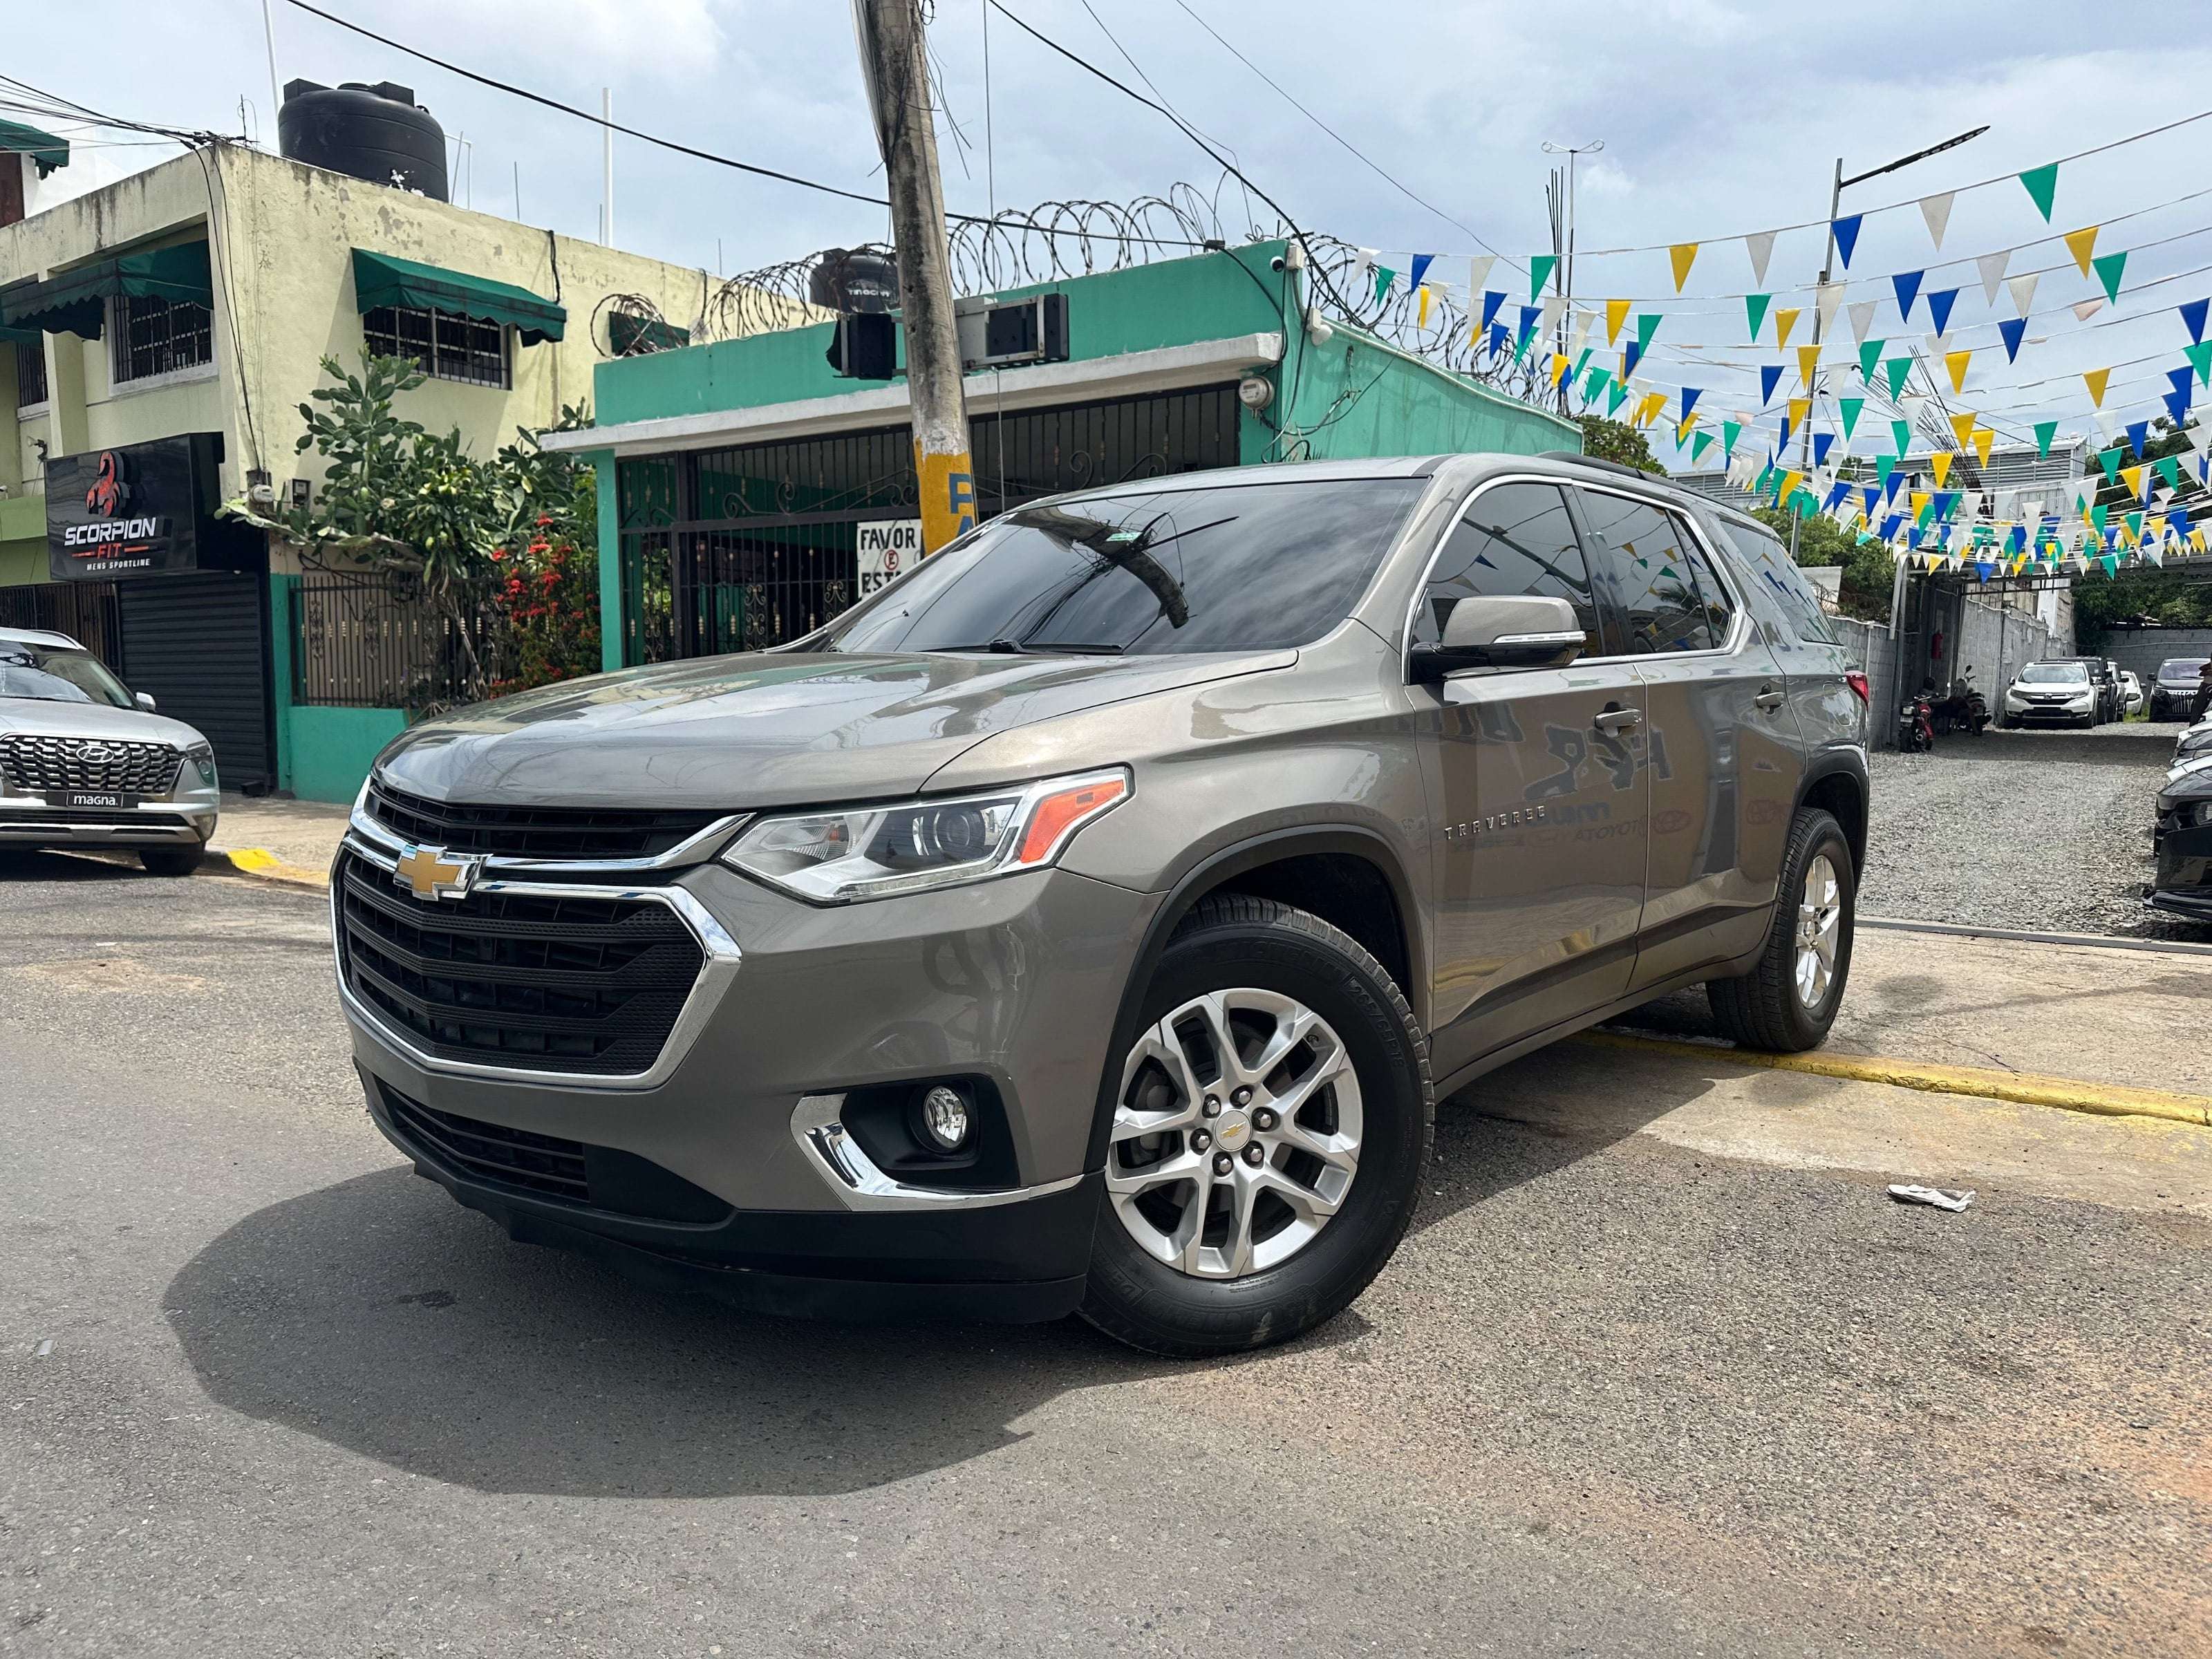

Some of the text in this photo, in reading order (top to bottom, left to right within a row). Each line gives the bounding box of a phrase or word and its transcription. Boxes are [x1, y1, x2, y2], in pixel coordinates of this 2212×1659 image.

[64, 517, 156, 546] SCORPION
[861, 528, 916, 550] FAVOR
[97, 543, 122, 559] FIT
[86, 558, 151, 570] MENS SPORTLINE
[861, 571, 901, 593] EST
[1443, 805, 1546, 841] TRAVERSE
